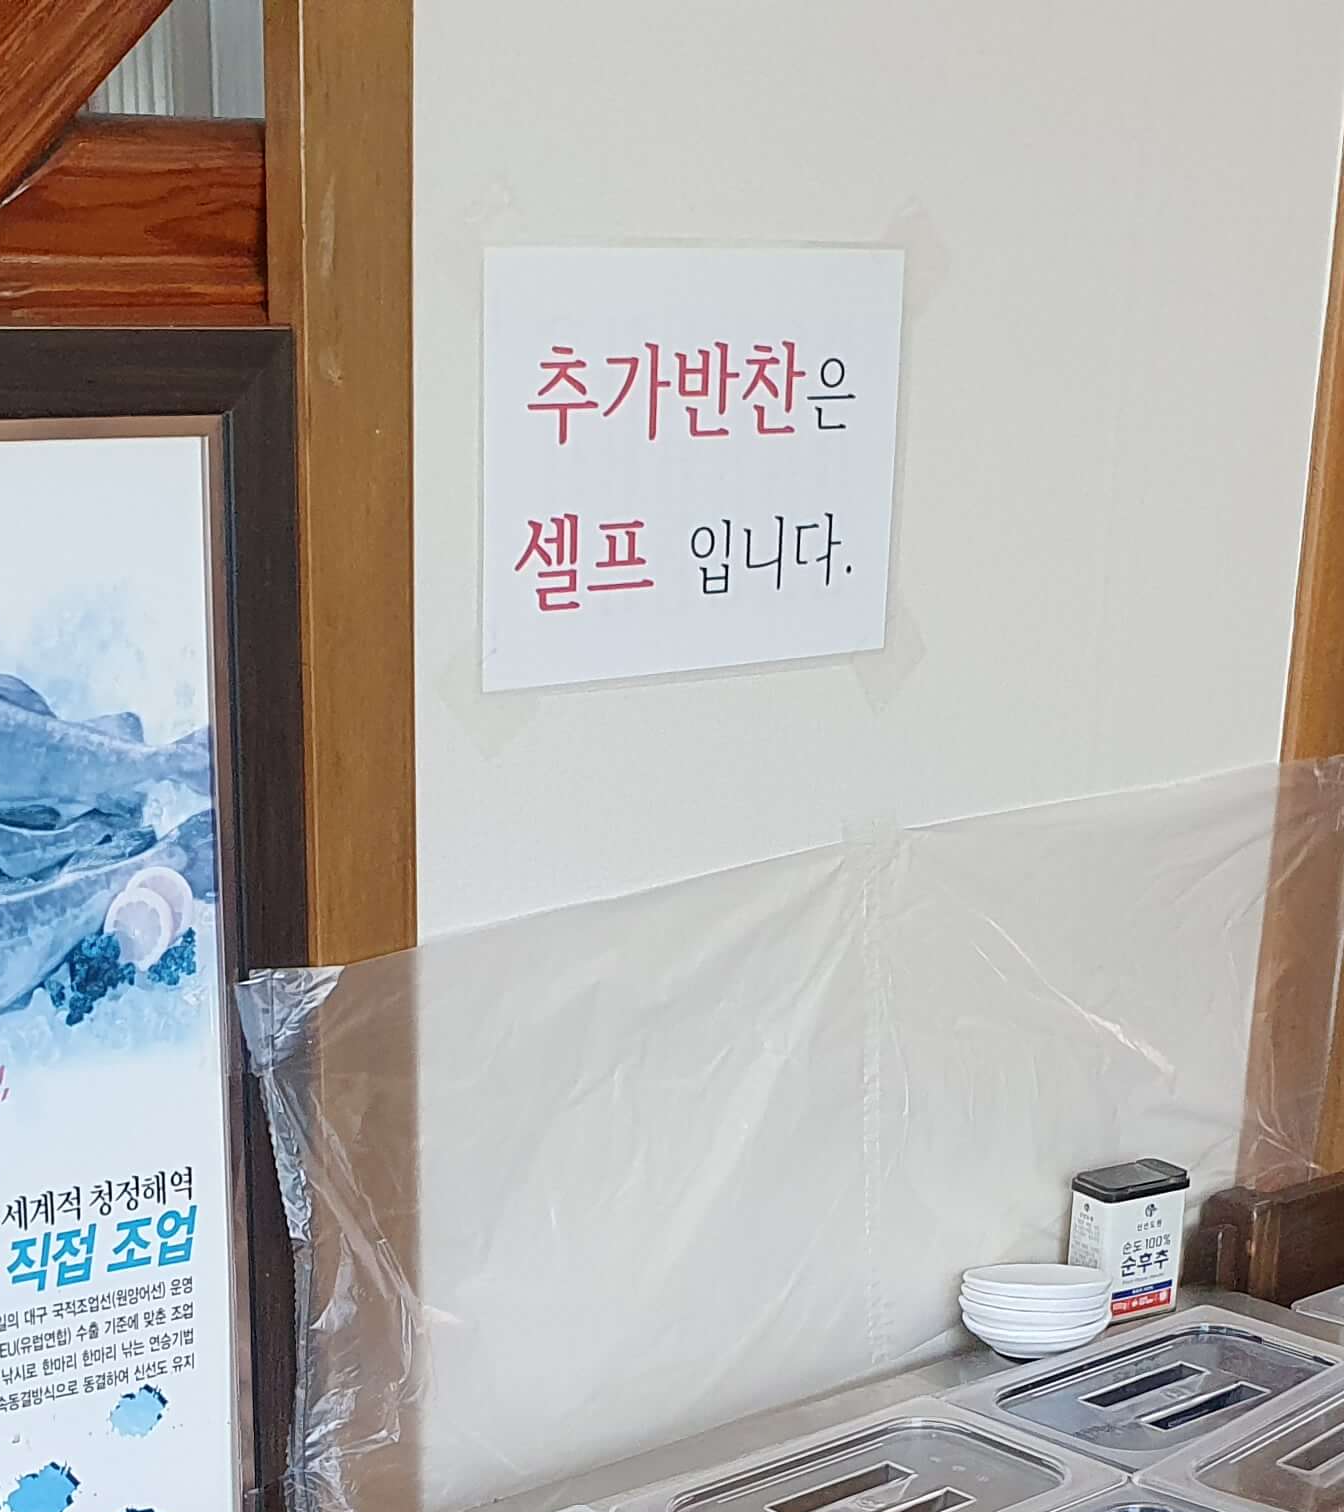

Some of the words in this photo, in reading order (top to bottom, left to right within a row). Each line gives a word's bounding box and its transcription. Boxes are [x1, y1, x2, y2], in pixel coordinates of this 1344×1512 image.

[527, 339, 856, 445] 추가반찬은
[514, 512, 655, 611] 셀프
[690, 511, 854, 595] 입니다.
[1, 1185, 82, 1232] 세계적
[89, 1166, 193, 1216] 청정해역
[7, 1222, 98, 1293] 직접
[106, 1205, 199, 1273] 조업
[1120, 1250, 1169, 1277] 순후추
[1122, 1240, 1142, 1255] 순도
[1145, 1234, 1171, 1249] 100%
[24, 1306, 48, 1325] 대구
[170, 1276, 193, 1296] 운영
[0, 1327, 71, 1359] EU(유럽연합)
[76, 1321, 99, 1342] 수출
[105, 1313, 139, 1334] 기준에
[144, 1307, 166, 1328] 맞춘
[171, 1302, 194, 1322] 조업
[1, 1363, 38, 1384] 낚시로
[42, 1352, 77, 1376] 한마리
[82, 1344, 117, 1367] 한마리
[121, 1340, 144, 1359] 낚는
[149, 1328, 194, 1352] 연승기법
[83, 1367, 129, 1393] 동결하여
[134, 1359, 168, 1382] 신선도
[172, 1352, 195, 1372] 유지
